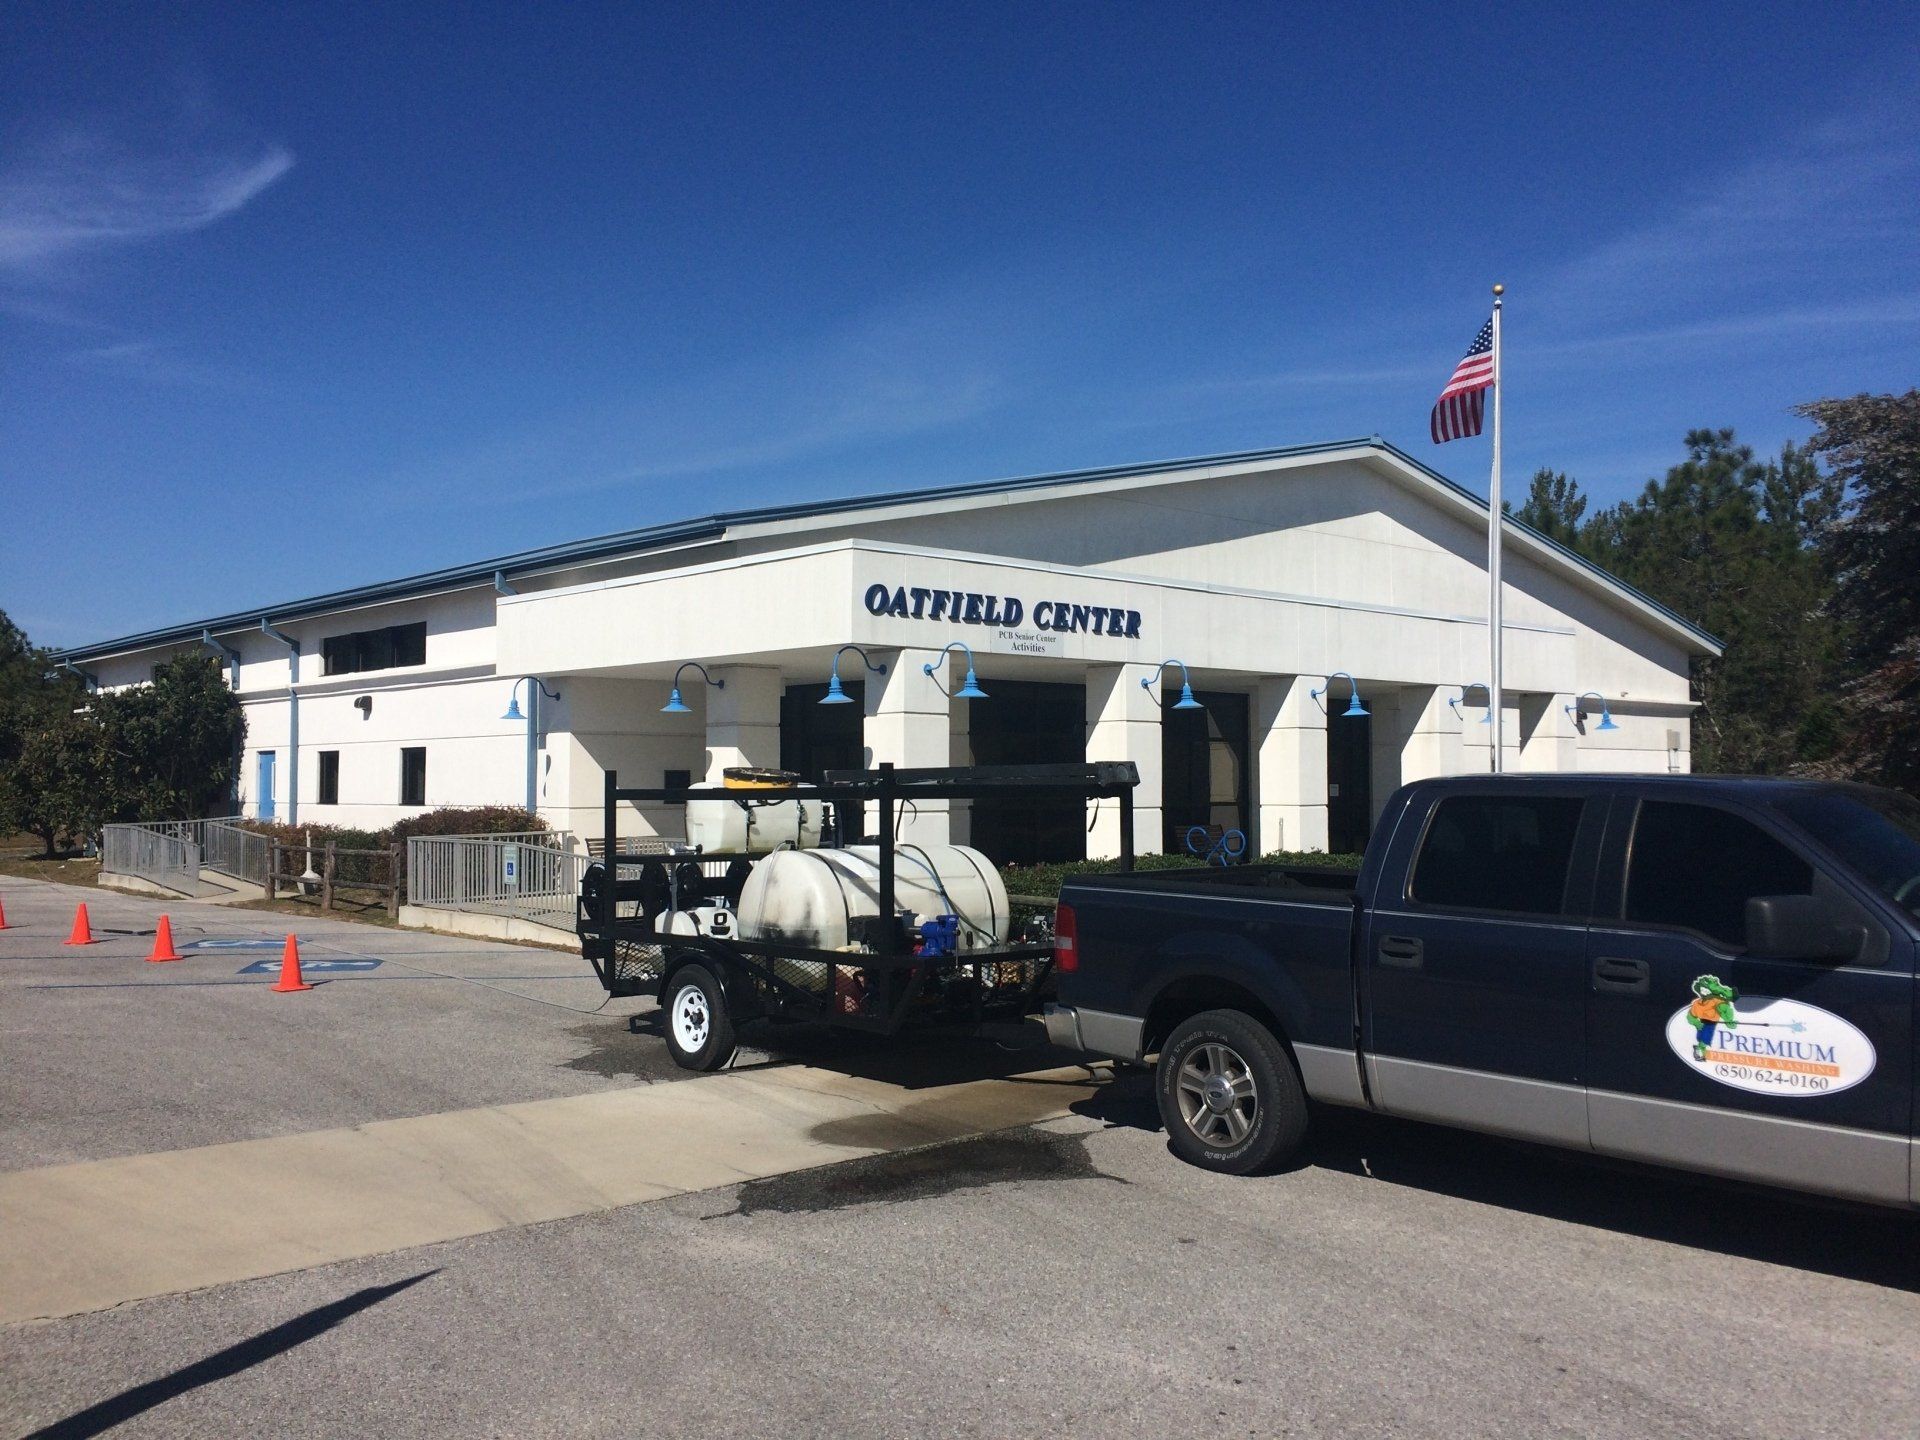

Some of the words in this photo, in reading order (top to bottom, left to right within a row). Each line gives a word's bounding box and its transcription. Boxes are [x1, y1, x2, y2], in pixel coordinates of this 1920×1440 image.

[865, 584, 1023, 627] OATFIELD
[1033, 601, 1141, 638] CENTER
[998, 631, 1013, 640] PCB
[1014, 632, 1034, 641] Senior
[1035, 633, 1056, 643] Center
[1011, 642, 1046, 653] Activities
[1718, 1030, 1837, 1063] PREMIUM
[1710, 1051, 1770, 1067] PRESSURE
[1775, 1060, 1836, 1074] WASHING
